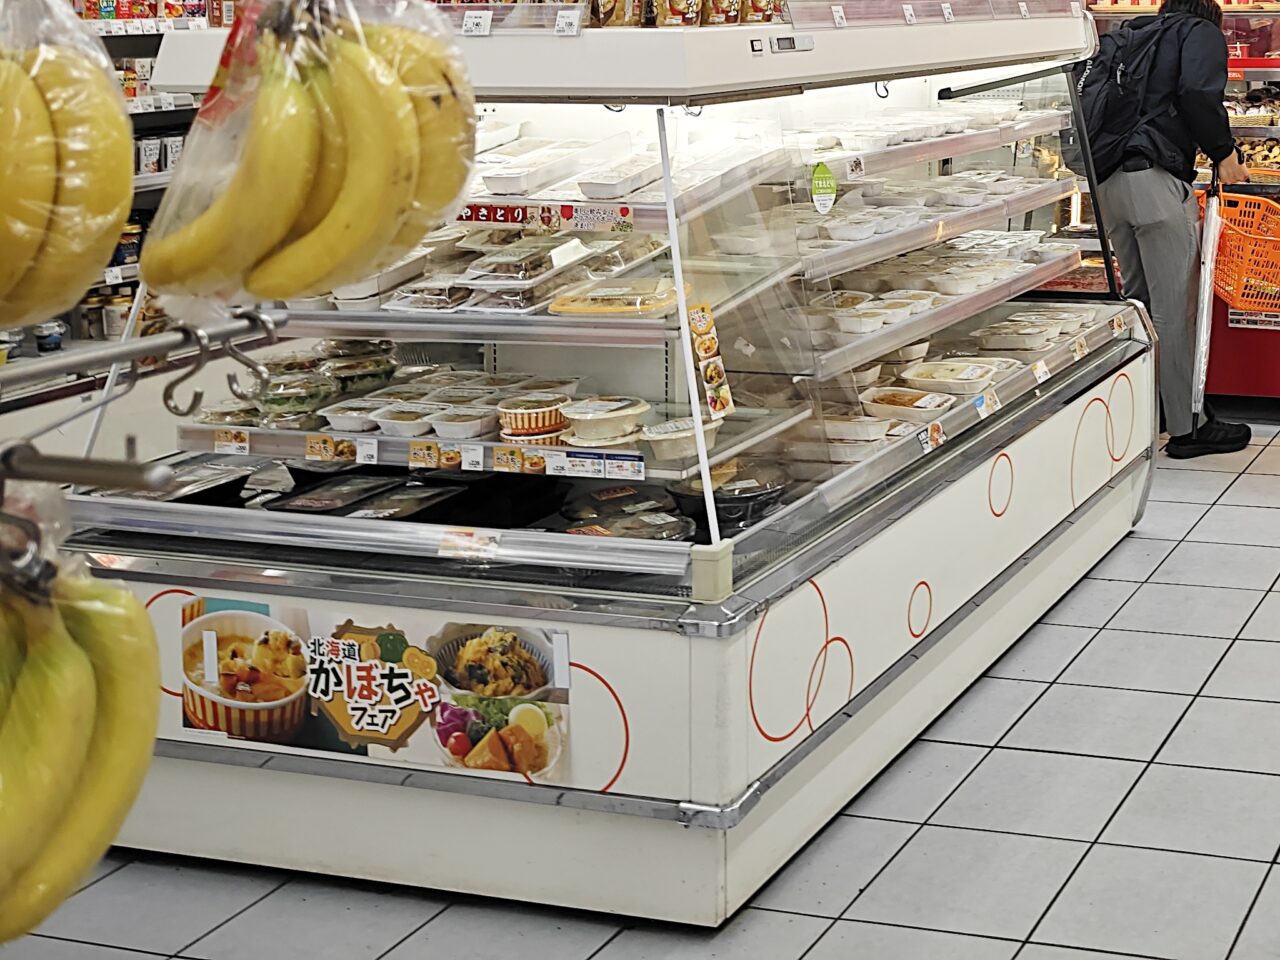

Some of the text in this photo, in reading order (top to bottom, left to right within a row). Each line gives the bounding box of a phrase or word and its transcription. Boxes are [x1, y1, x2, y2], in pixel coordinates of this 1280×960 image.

[1077, 59, 1093, 96] ALOMON
[459, 207, 523, 221] やきとり
[310, 638, 358, 660] 北海道
[309, 660, 437, 708] かぼちゃ
[351, 707, 397, 729] フェア
